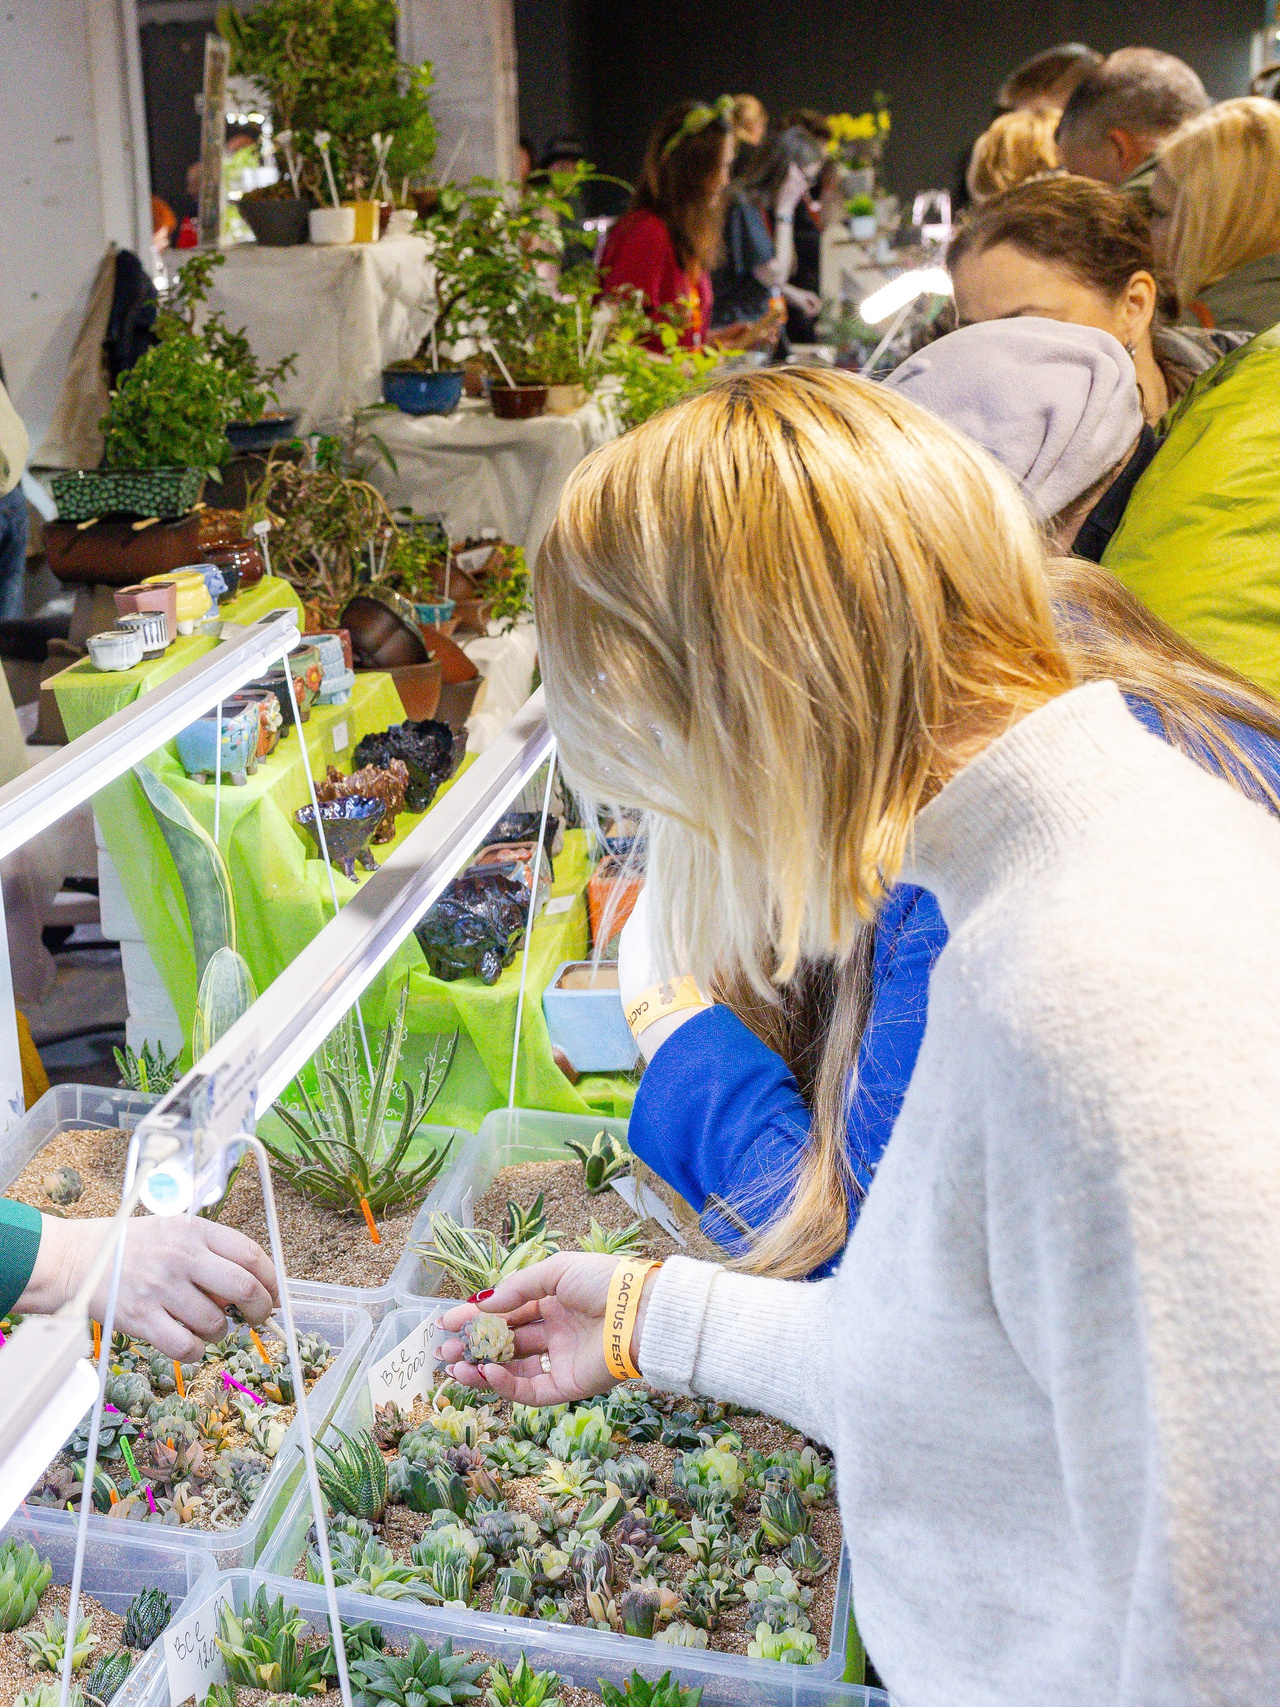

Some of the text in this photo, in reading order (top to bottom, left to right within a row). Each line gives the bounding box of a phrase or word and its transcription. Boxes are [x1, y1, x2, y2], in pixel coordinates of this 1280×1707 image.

[612, 1272, 634, 1331] CACTUS
[397, 1350, 426, 1390] 2000
[611, 1334, 626, 1369] FEST
